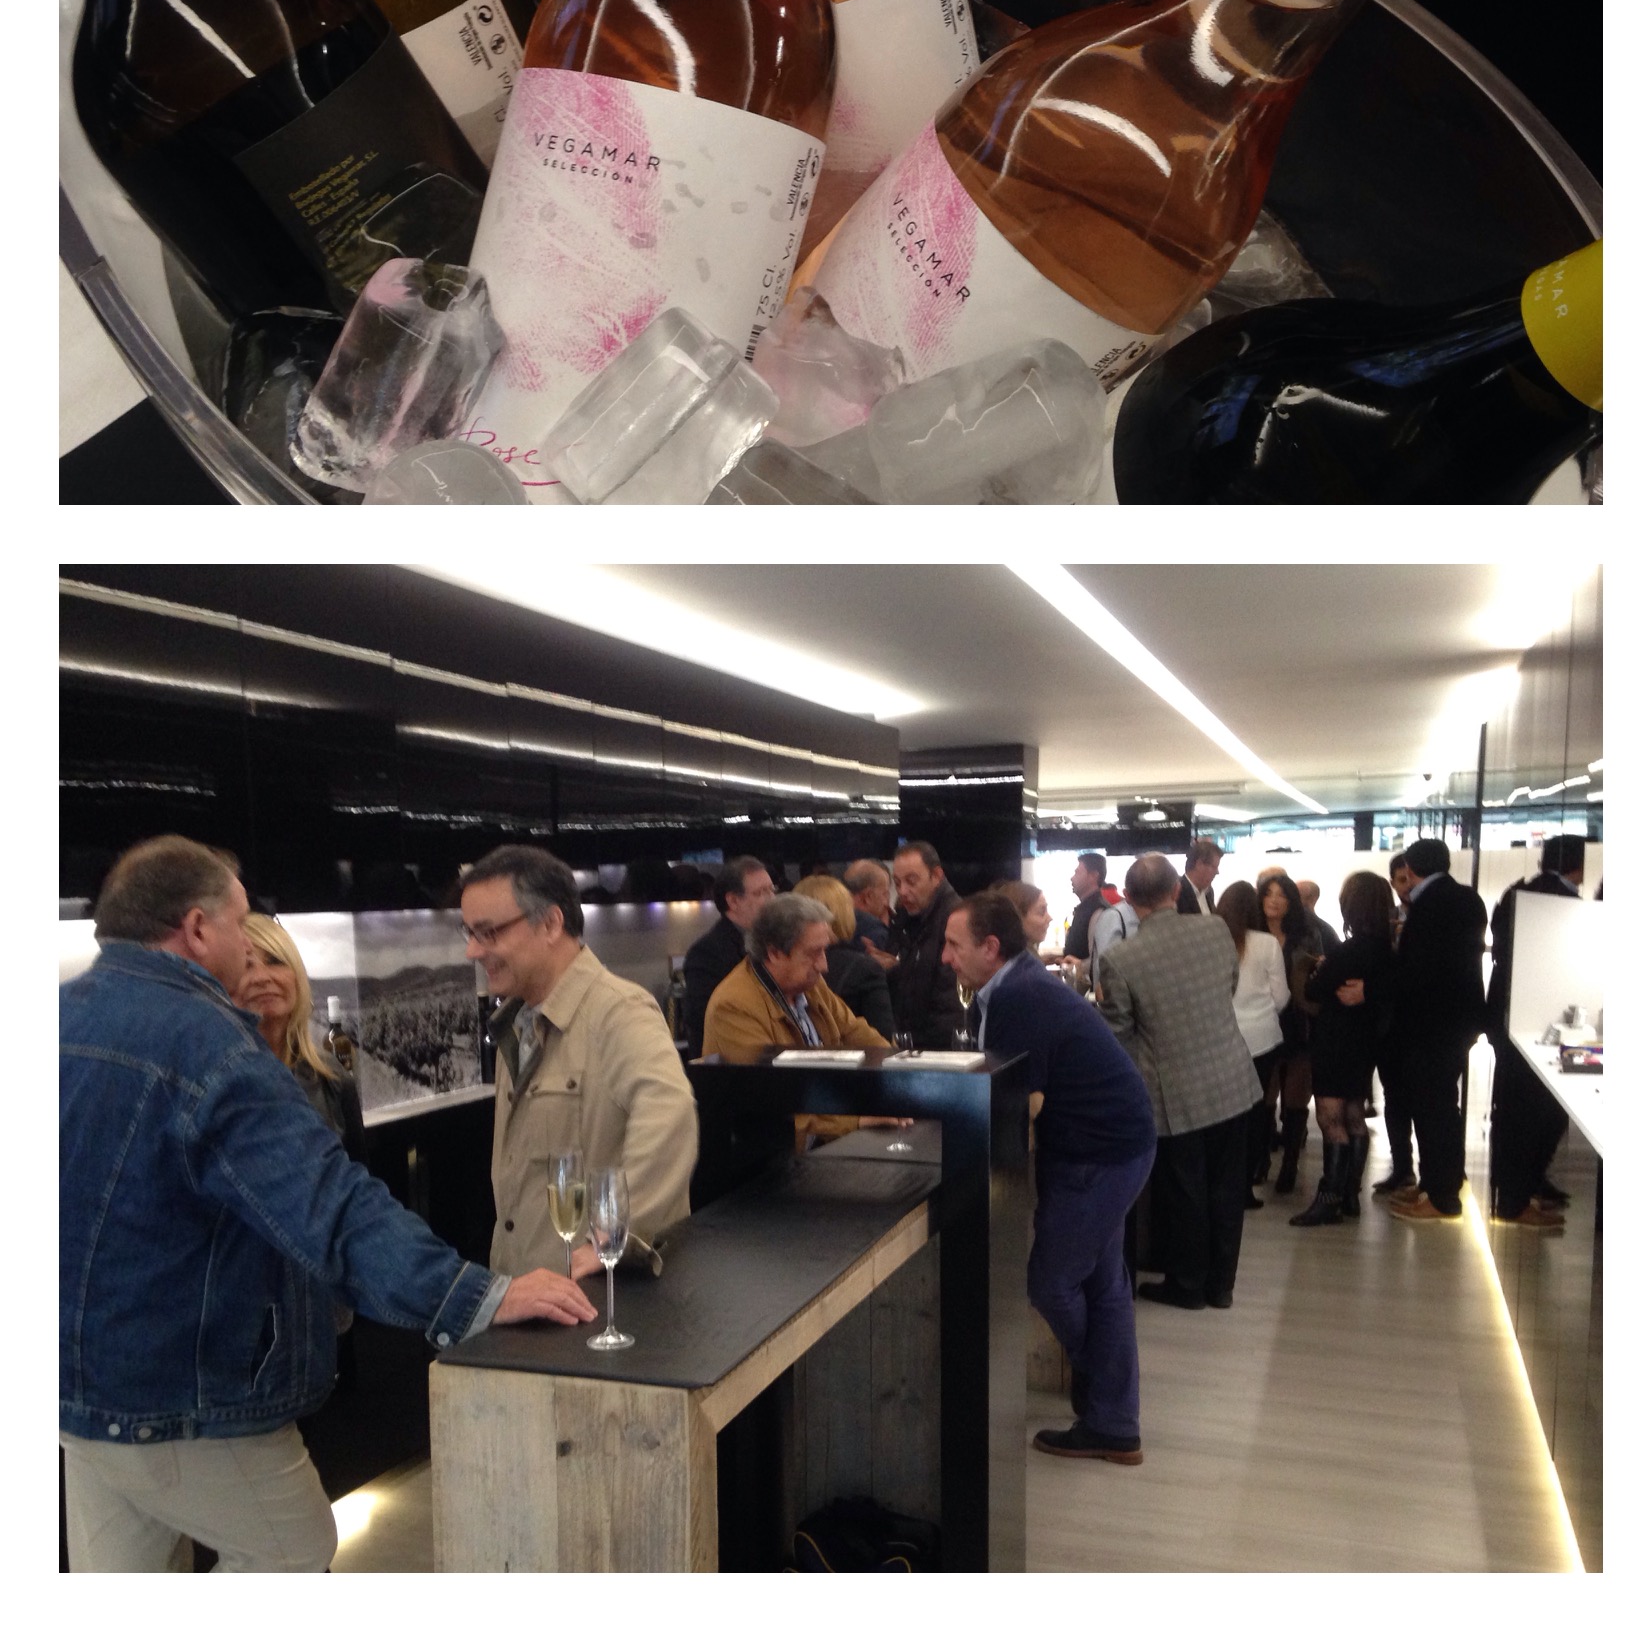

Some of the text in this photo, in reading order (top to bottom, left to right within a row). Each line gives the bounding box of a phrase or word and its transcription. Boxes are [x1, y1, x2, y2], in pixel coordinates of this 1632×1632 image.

[534, 132, 660, 172] VEGAMAR
[893, 193, 971, 303] VEGAMAR
[756, 294, 770, 317] 75
